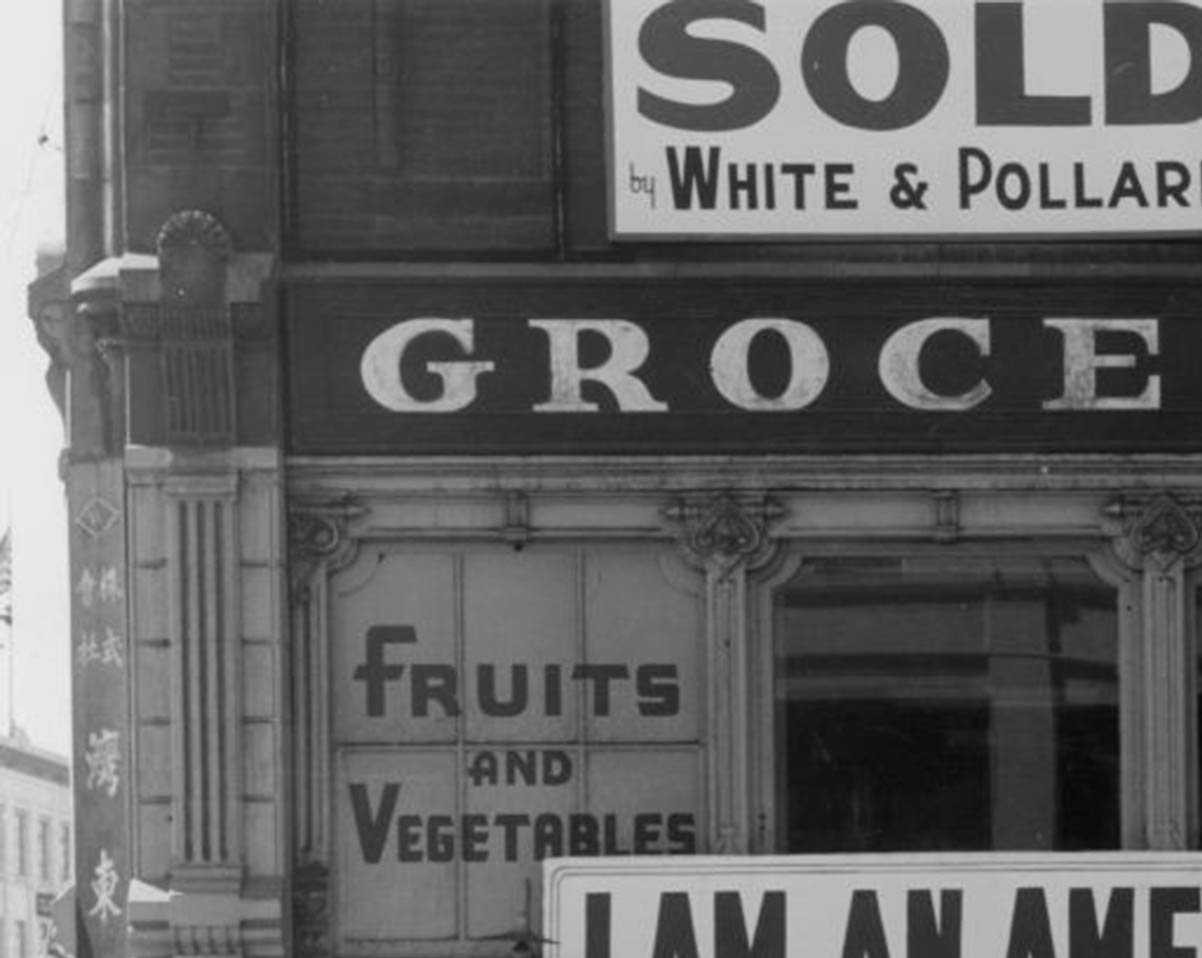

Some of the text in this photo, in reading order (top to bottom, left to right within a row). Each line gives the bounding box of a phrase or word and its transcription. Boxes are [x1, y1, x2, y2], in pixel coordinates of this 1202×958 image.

[629, 164, 656, 210] by
[666, 146, 858, 210] WHITE
[890, 163, 928, 210] &
[467, 750, 573, 787] AND
[348, 782, 697, 864] VEGETABLES
